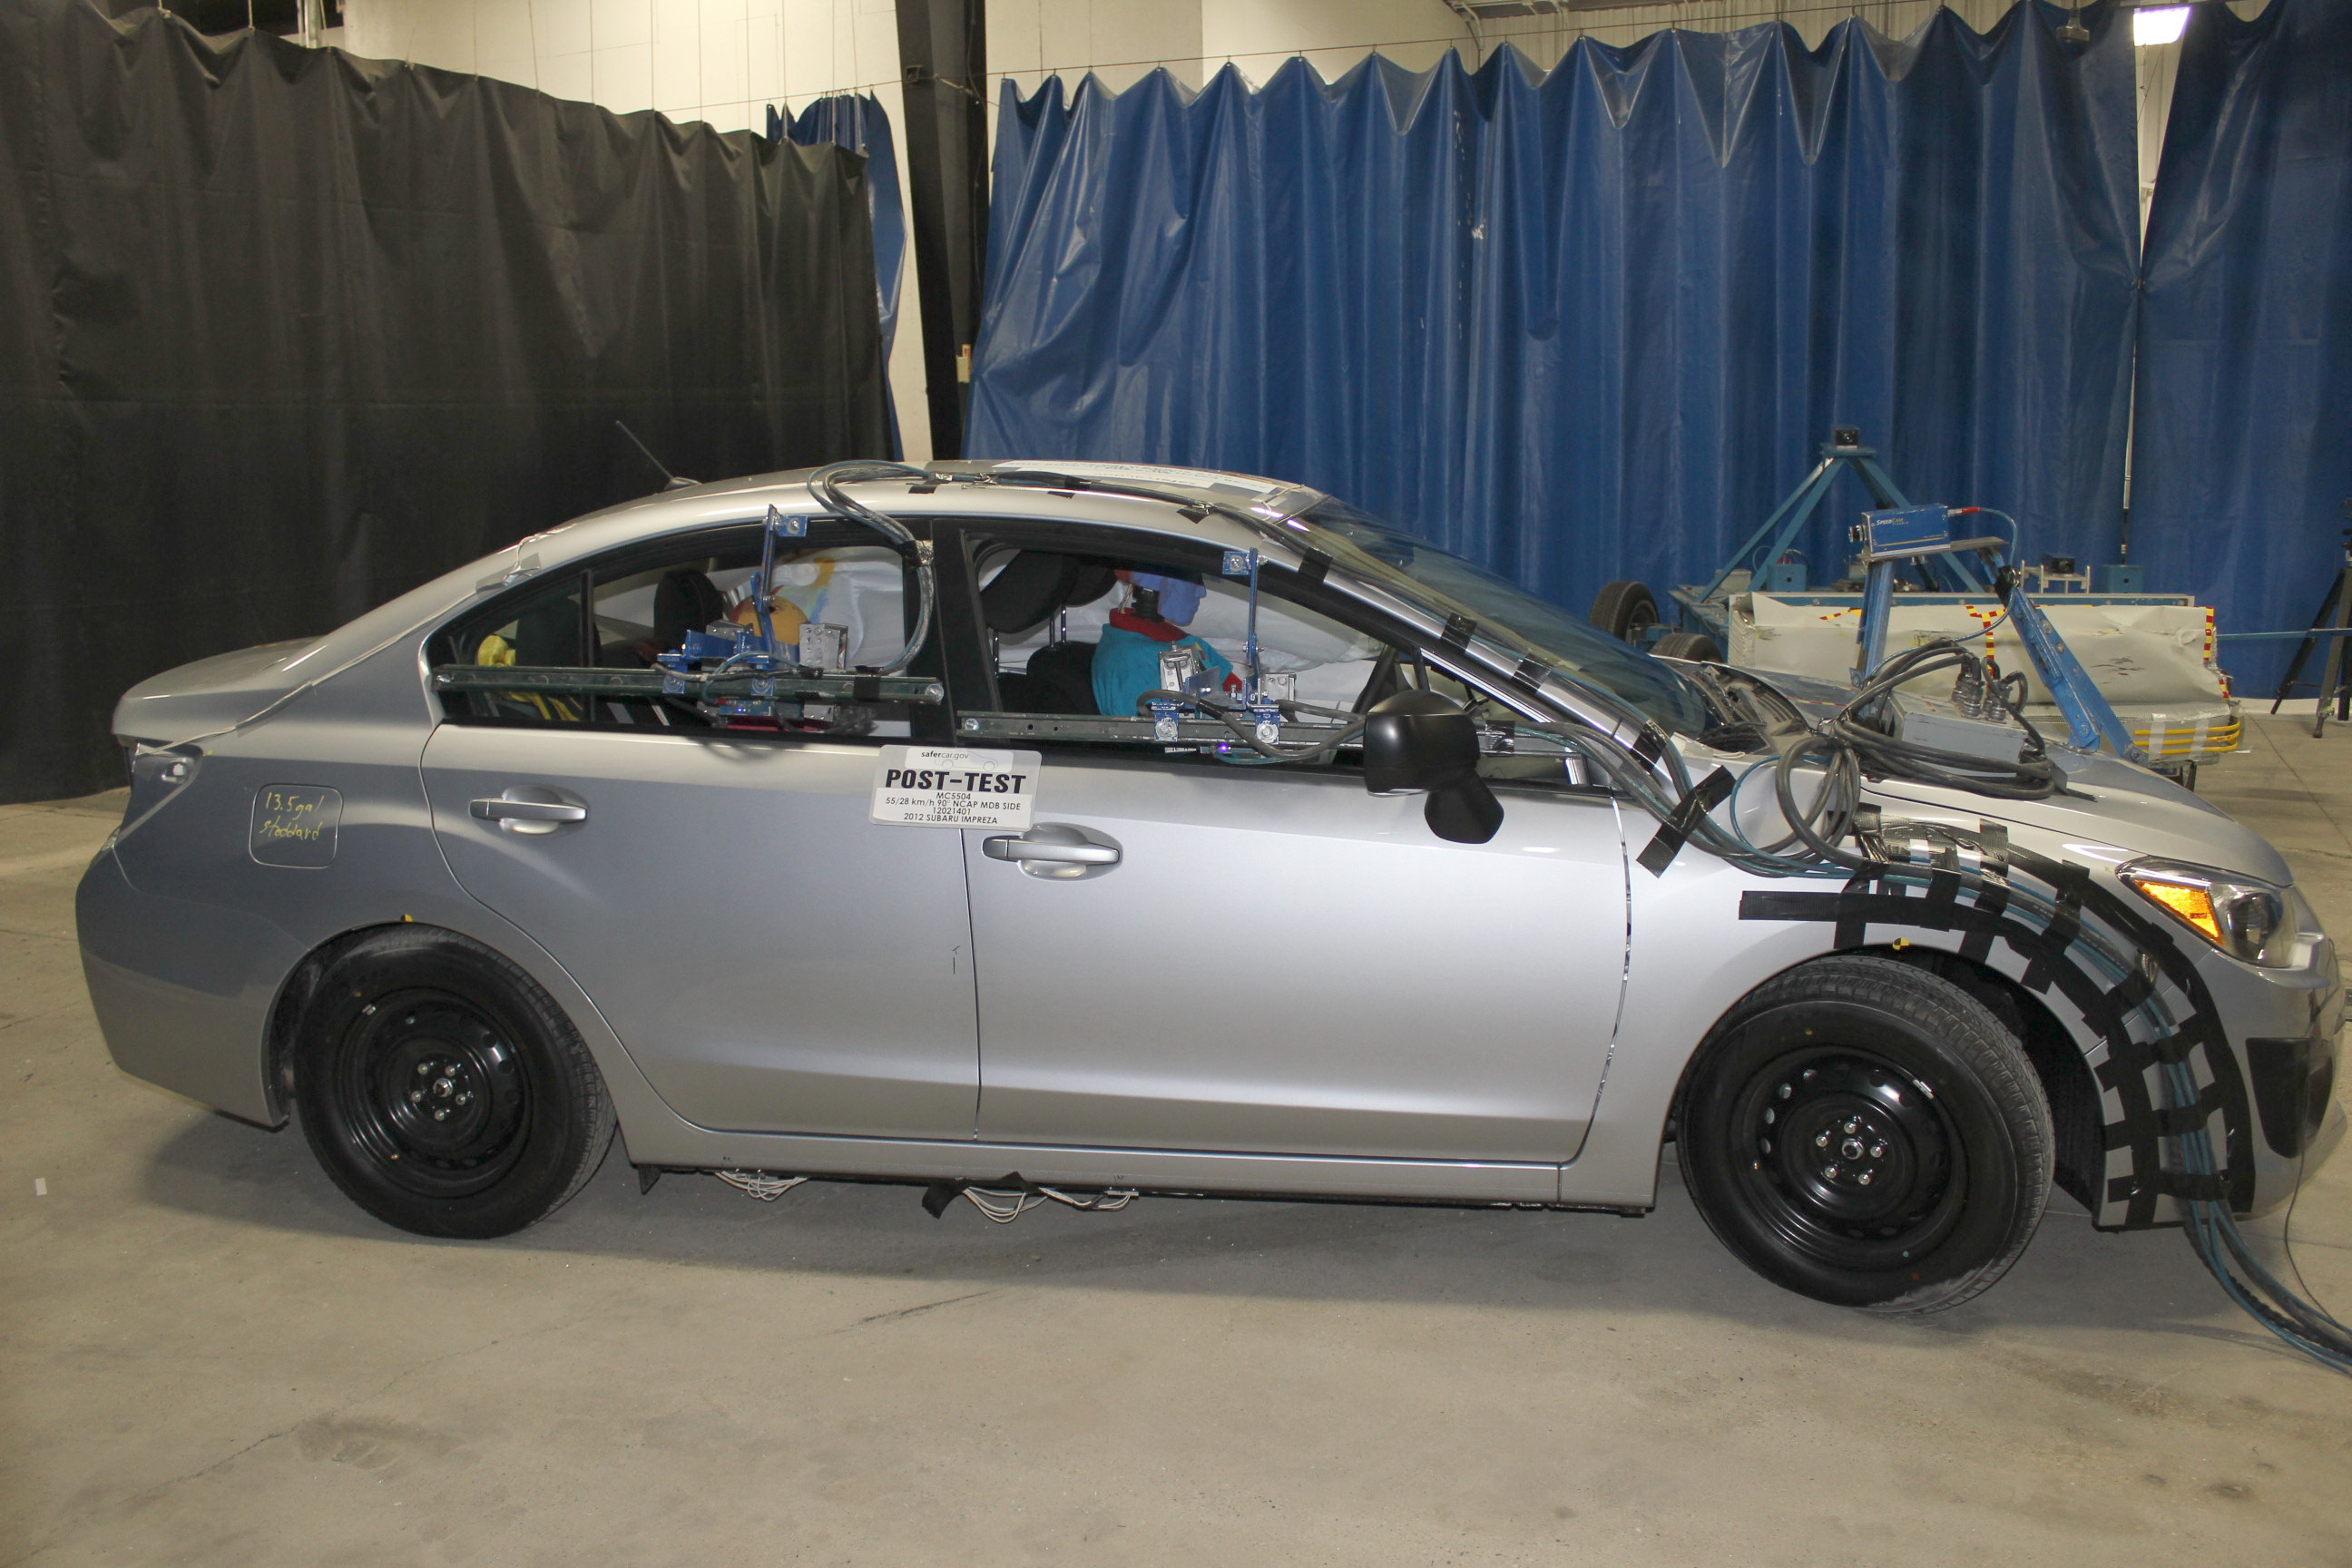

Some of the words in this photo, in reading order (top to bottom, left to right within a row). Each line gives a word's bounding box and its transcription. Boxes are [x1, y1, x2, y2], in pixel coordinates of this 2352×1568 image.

[921, 750, 969, 760] safercar.gov
[885, 769, 1027, 794] POST-TEST
[936, 792, 971, 800] MC5504
[886, 797, 909, 806] 55/28
[911, 798, 935, 807] km/h
[953, 800, 978, 808] NCAP
[980, 801, 1000, 809] MDB
[1003, 802, 1021, 810] SIDE
[933, 807, 971, 816] 12021401
[904, 813, 924, 821] 2012
[926, 814, 959, 822] SUBARU
[961, 815, 998, 824] IMPREZA
